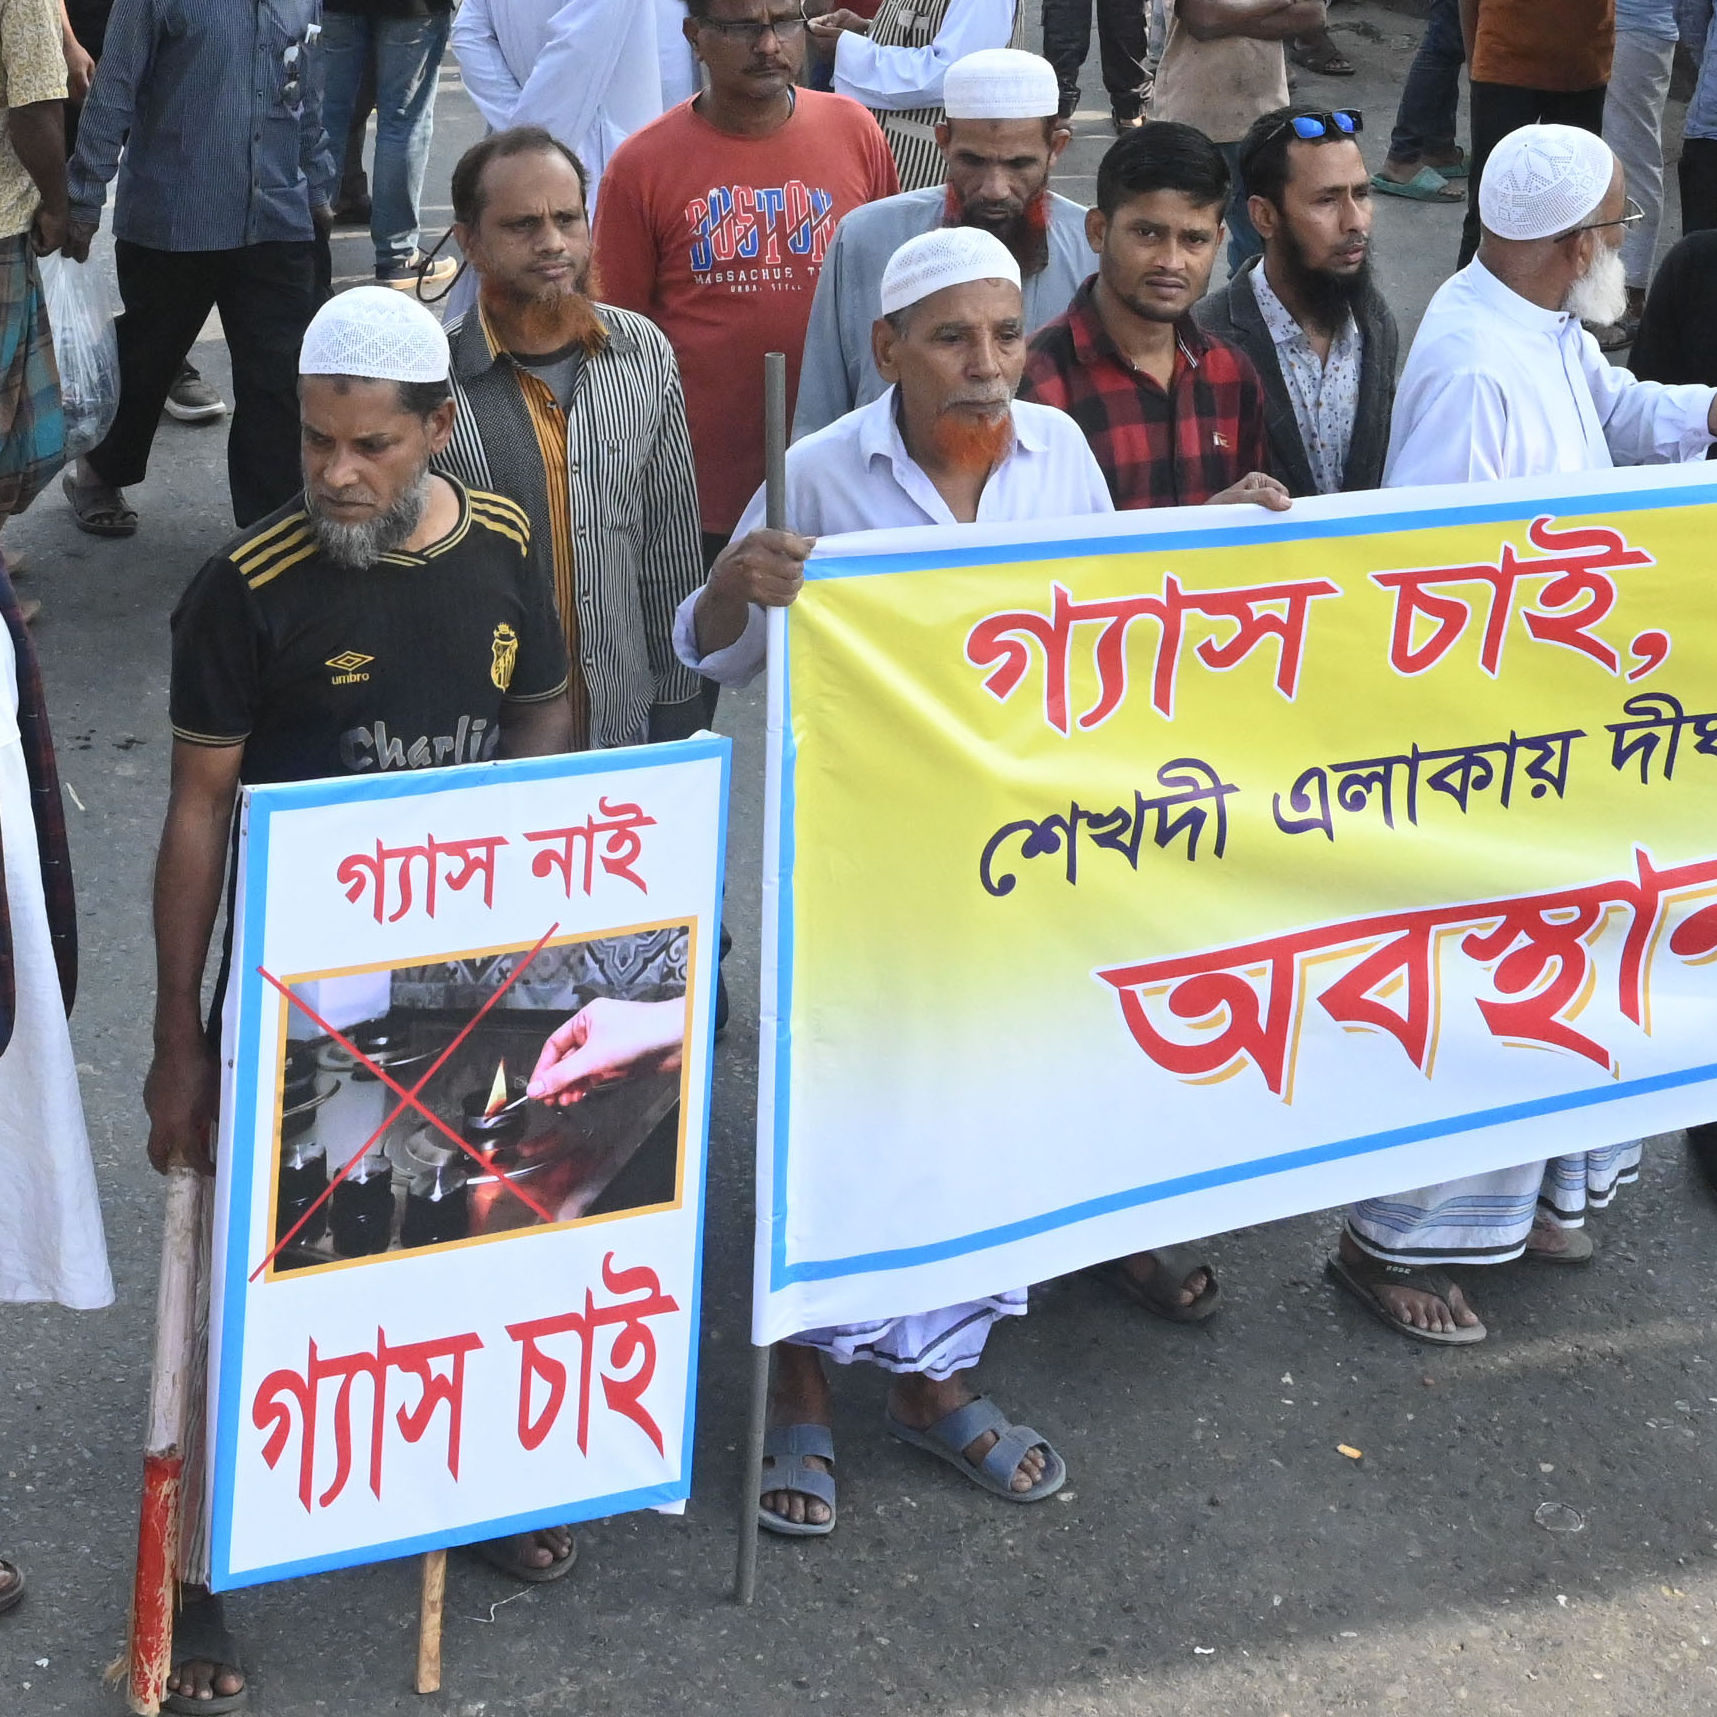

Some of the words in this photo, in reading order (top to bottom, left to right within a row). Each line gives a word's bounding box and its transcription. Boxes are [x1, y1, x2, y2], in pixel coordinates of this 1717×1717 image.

[685, 180, 836, 272] BOSTON
[331, 671, 370, 686] umbro
[967, 573, 1341, 737] গ্যাস
[1373, 515, 1670, 683] চাই,
[337, 834, 510, 924] গ্যাস
[525, 795, 658, 898] নাই
[980, 756, 1238, 896] শেখদী
[1273, 728, 1585, 842] এলাকায়
[252, 1324, 485, 1515] গ্যাস
[505, 1249, 680, 1458] চাই
